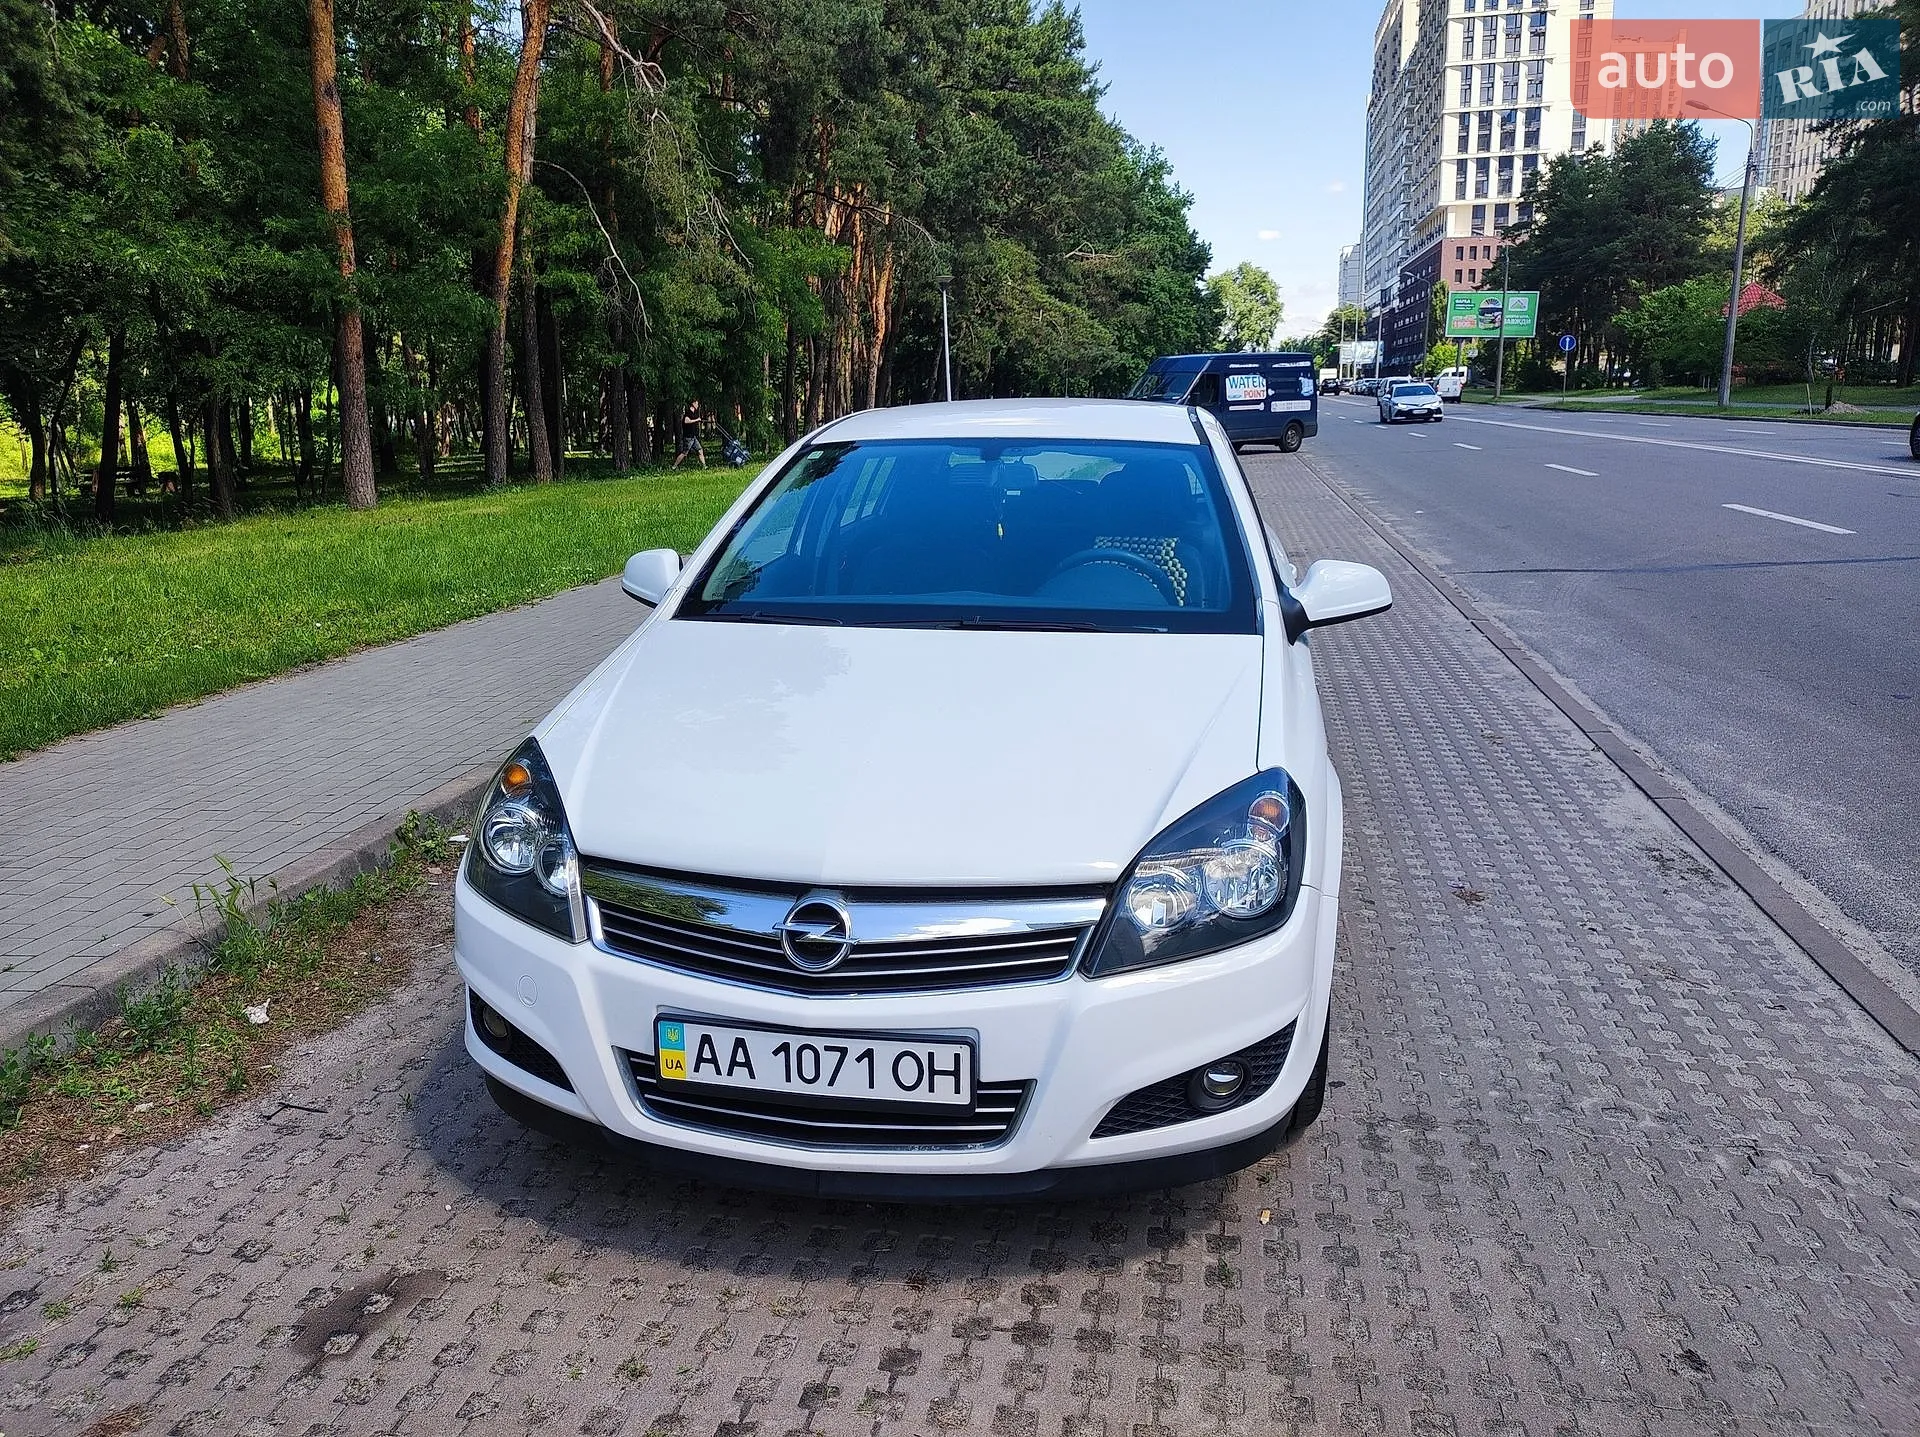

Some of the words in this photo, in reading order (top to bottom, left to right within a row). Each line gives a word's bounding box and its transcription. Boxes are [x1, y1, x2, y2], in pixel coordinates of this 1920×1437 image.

[1244, 389, 1265, 399] POINT
[665, 1058, 684, 1072] UA
[693, 1033, 756, 1080] AA
[771, 1041, 875, 1090] 1071
[891, 1049, 961, 1095] OH
